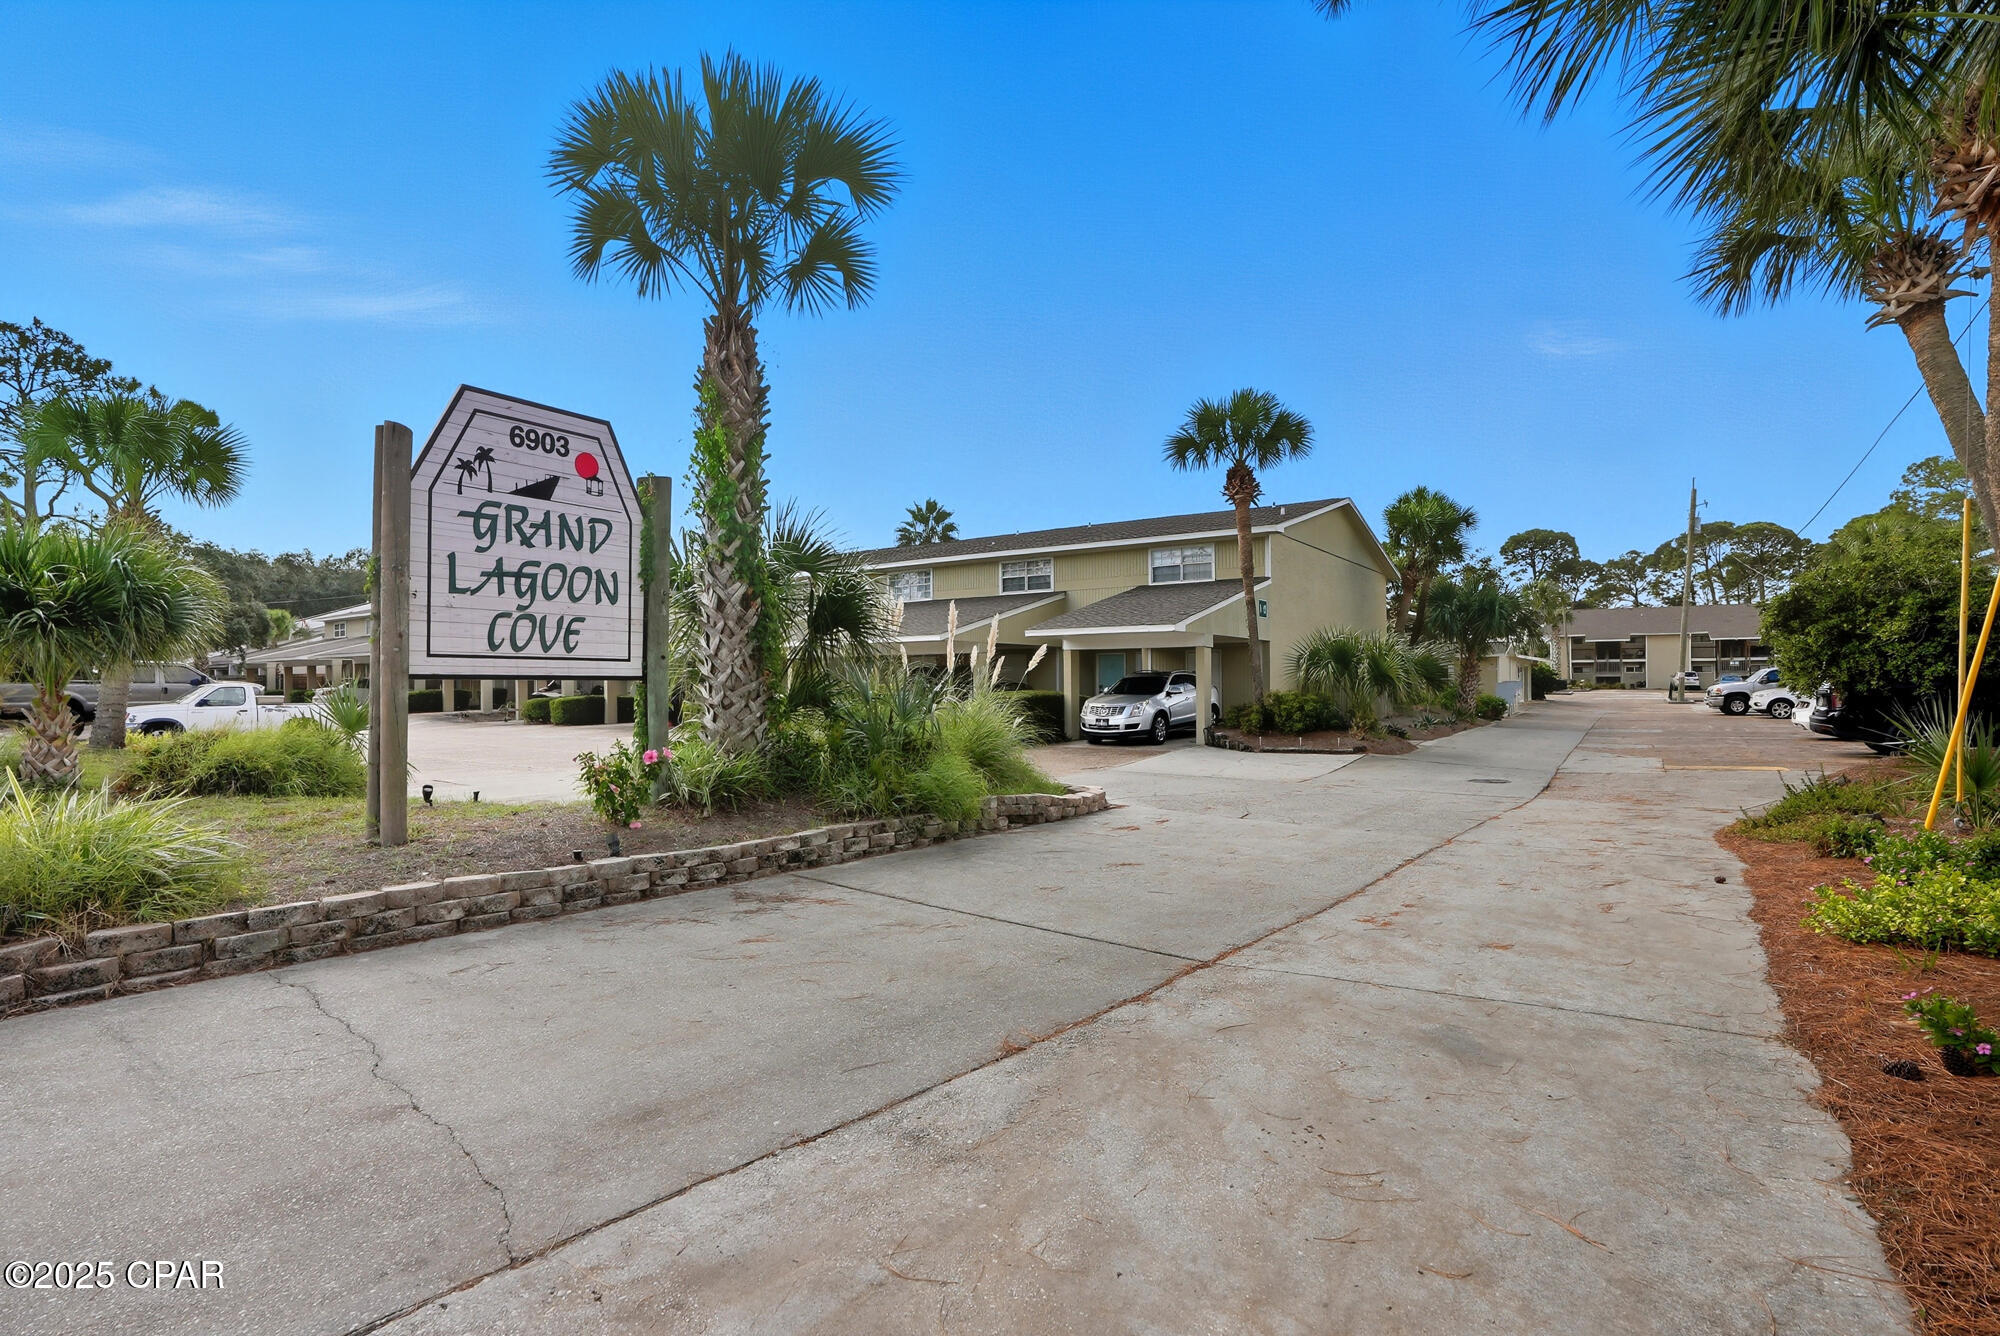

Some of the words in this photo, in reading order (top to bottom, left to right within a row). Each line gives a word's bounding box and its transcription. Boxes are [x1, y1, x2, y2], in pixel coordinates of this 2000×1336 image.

[509, 426, 570, 457] 6903
[457, 501, 613, 553] GRAND
[447, 552, 619, 611] LAGOON
[488, 613, 585, 653] COVE
